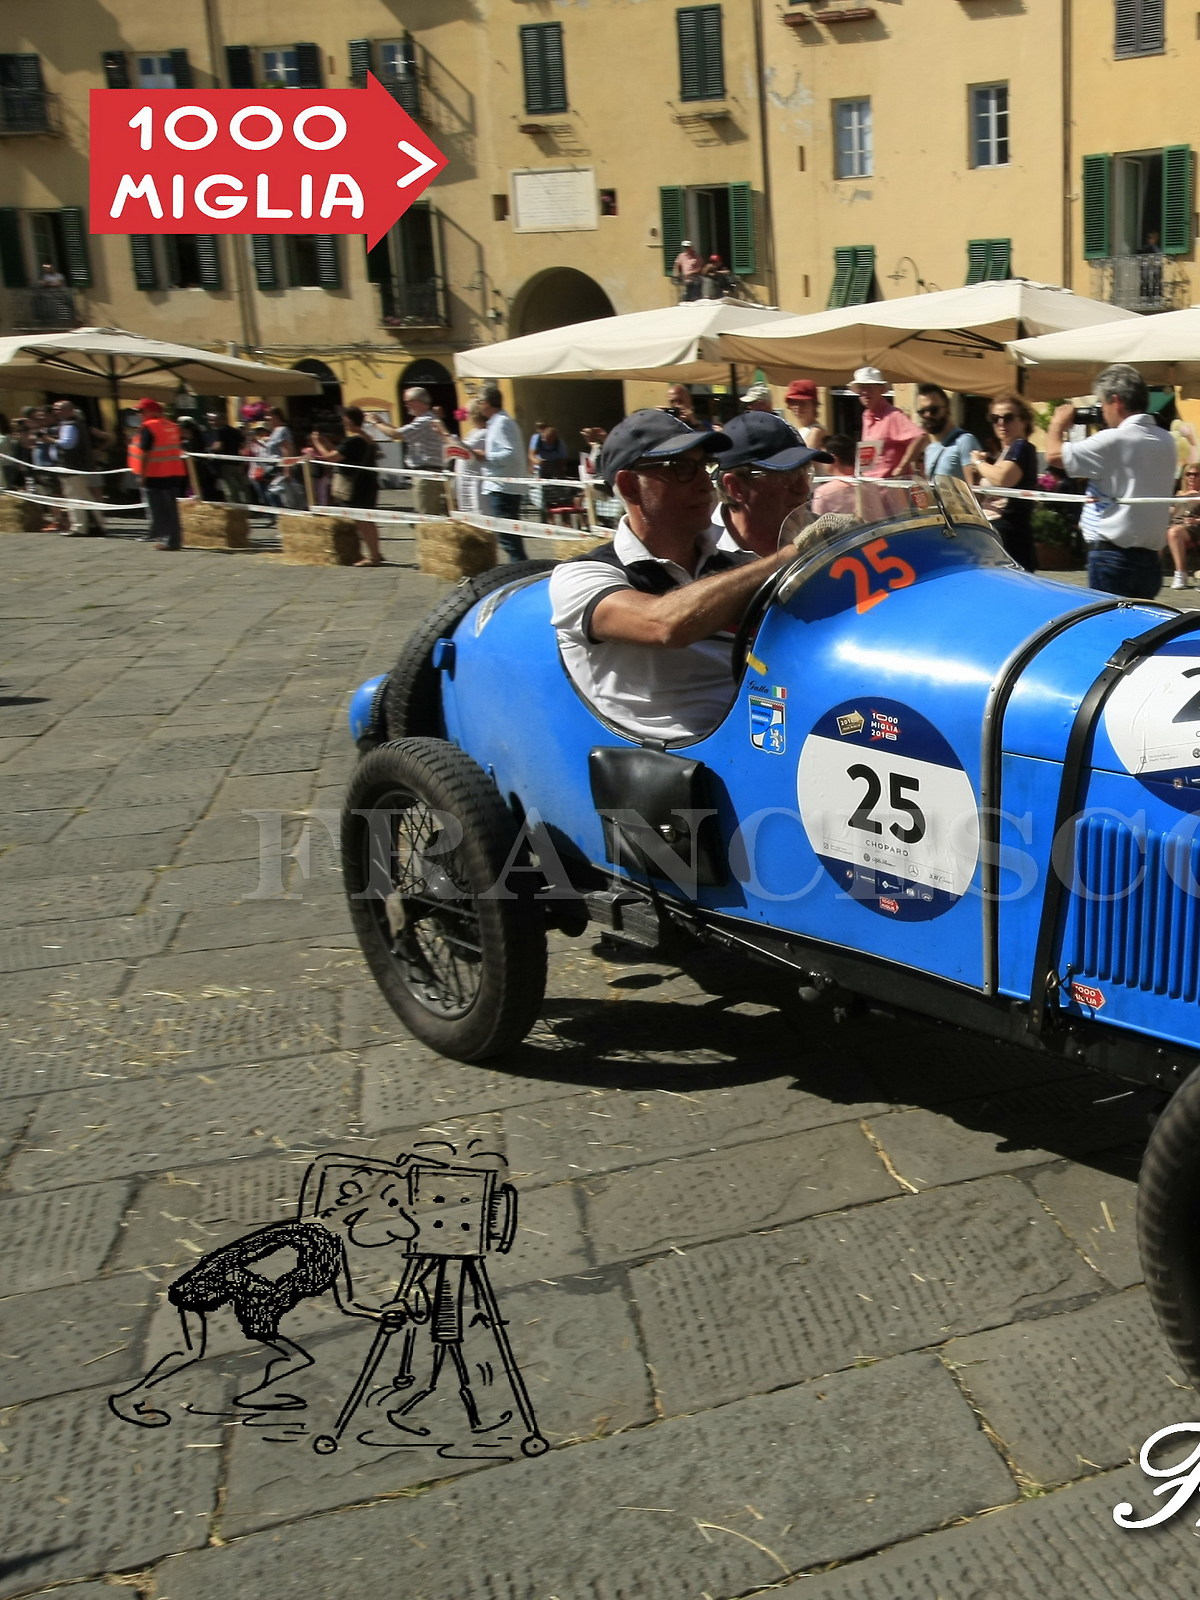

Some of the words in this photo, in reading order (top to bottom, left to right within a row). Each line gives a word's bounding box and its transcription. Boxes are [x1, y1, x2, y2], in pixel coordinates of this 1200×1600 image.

[829, 537, 916, 615] 25
[870, 720, 899, 733] MIGLIA
[872, 712, 899, 724] 1000
[846, 763, 927, 844] 25
[865, 839, 909, 857] CHOPARD
